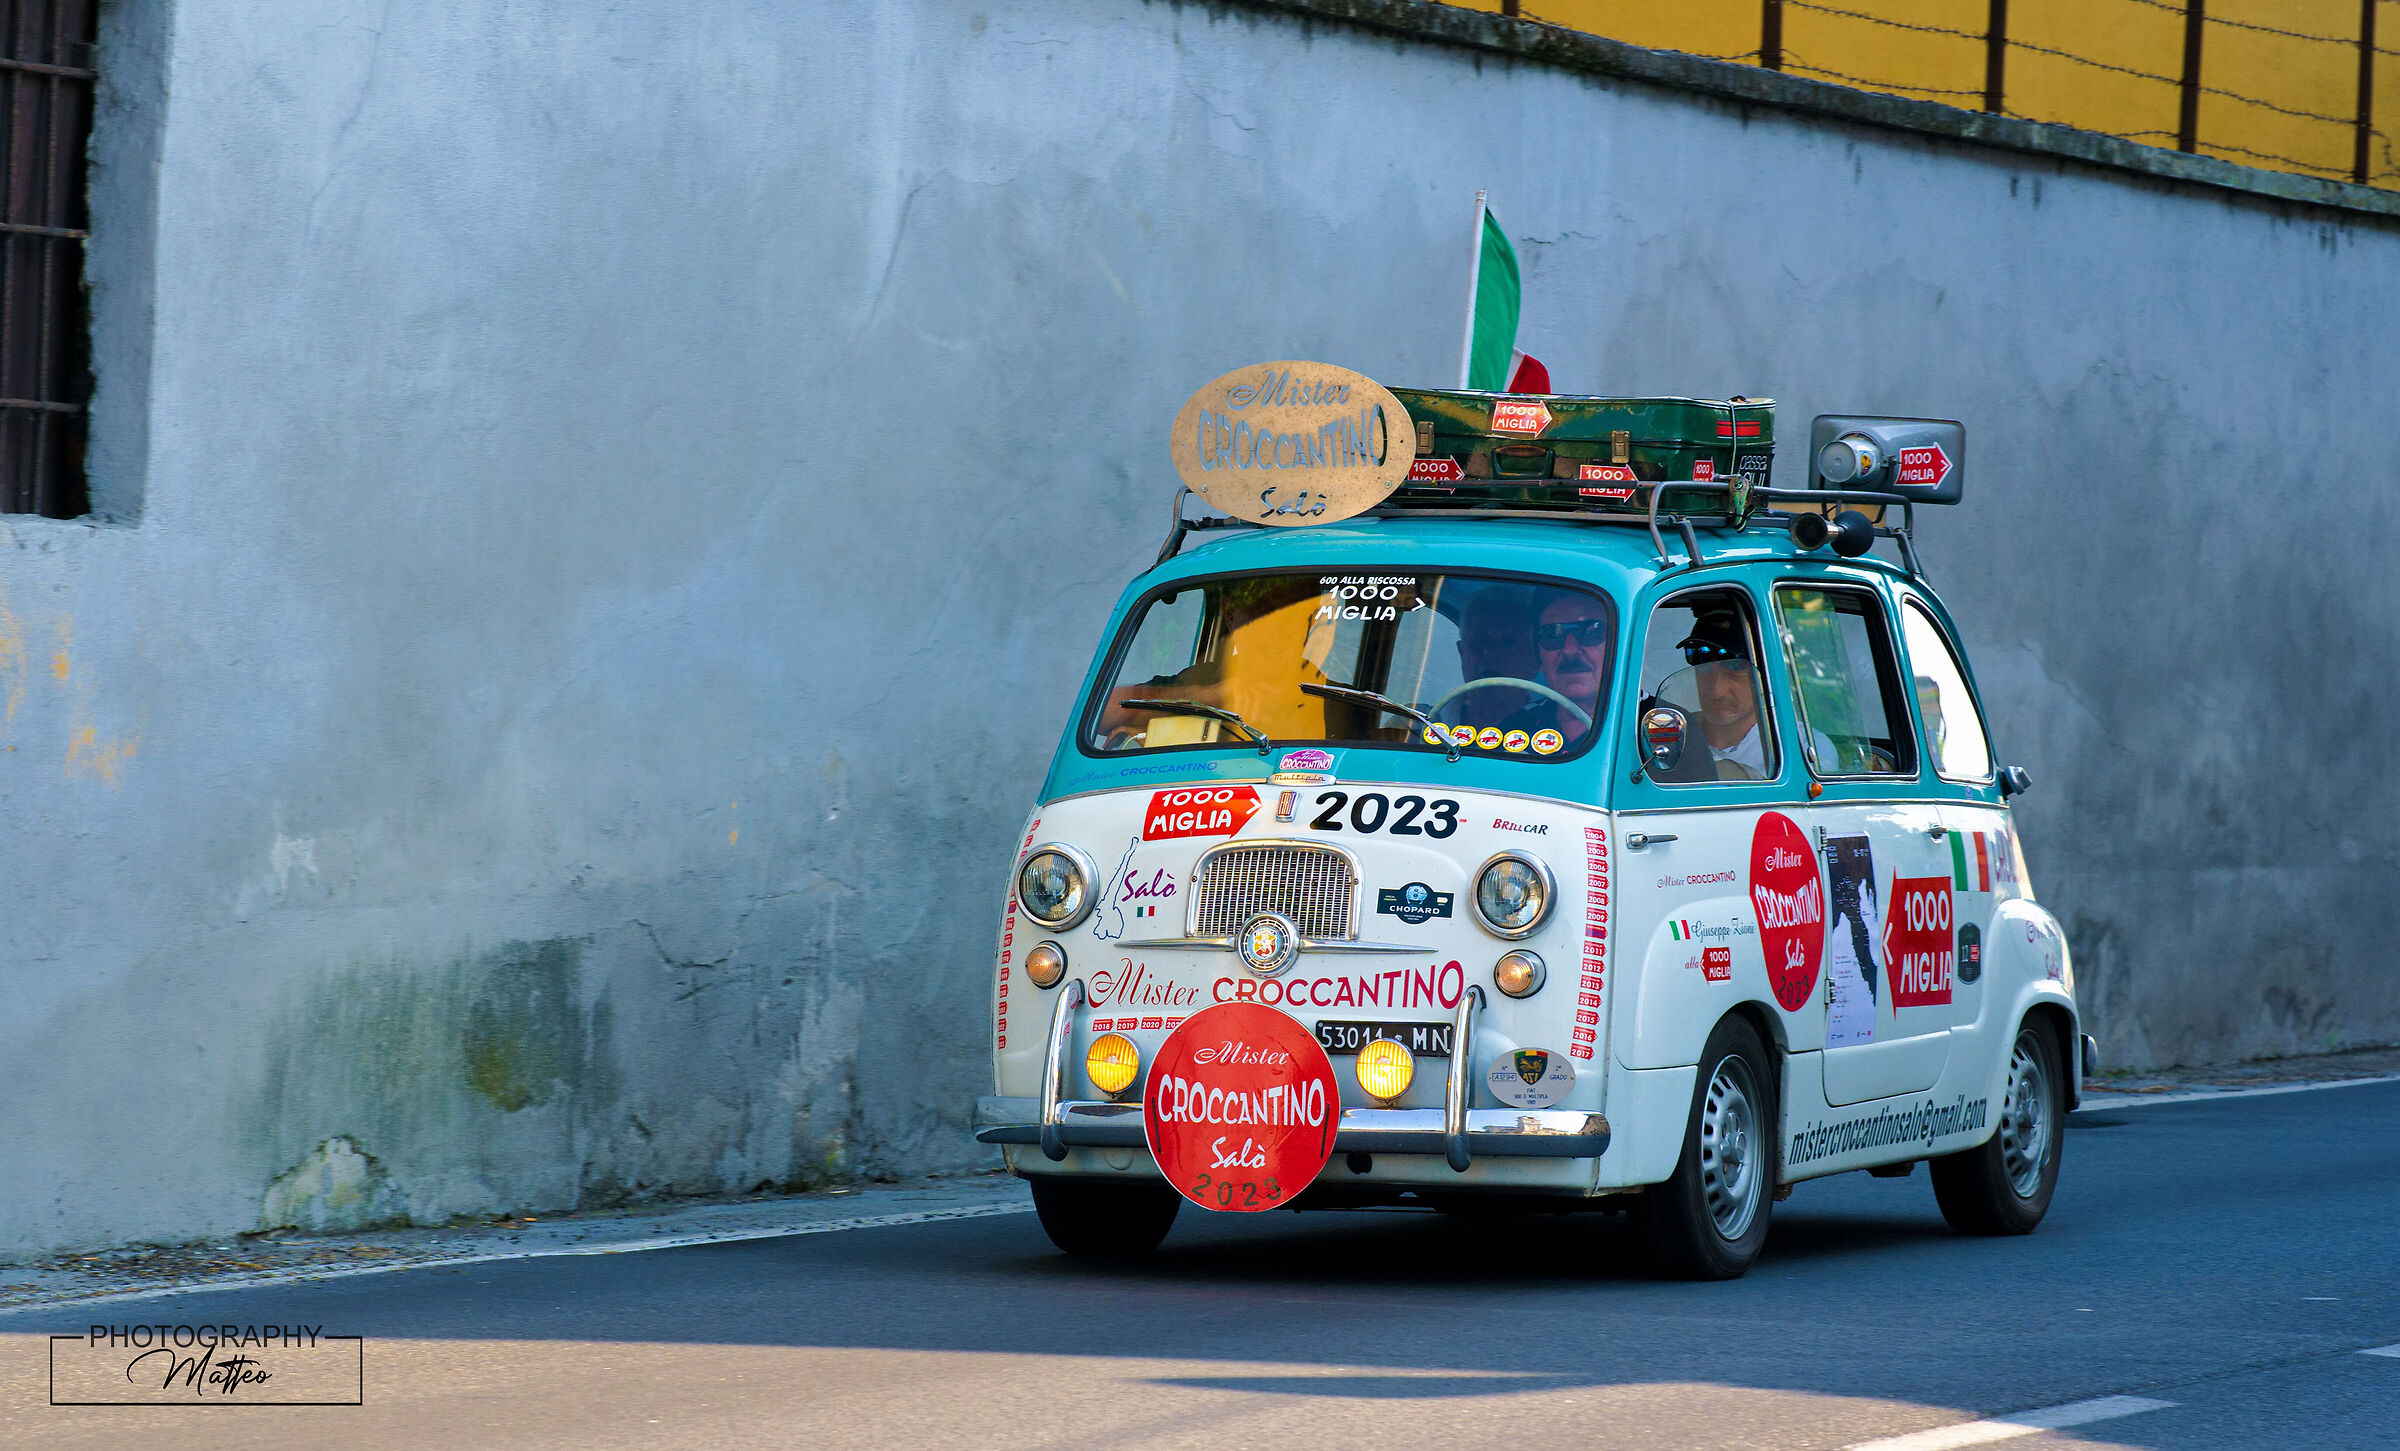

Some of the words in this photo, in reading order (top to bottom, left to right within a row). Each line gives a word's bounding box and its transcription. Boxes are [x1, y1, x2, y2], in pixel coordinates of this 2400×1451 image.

[1227, 370, 1350, 411] Mister
[1502, 406, 1536, 416] 1000
[1496, 418, 1537, 430] MIGLIA
[1198, 403, 1387, 471] CROCCANTINO
[1904, 453, 1932, 465] 1000
[1414, 463, 1448, 473] 1000
[1696, 465, 1710, 474] 1000
[1586, 470, 1623, 480] 1000
[1900, 468, 1935, 481] MIGLIA
[1260, 487, 1327, 518] Salò
[1320, 576, 1338, 584] 600
[1340, 576, 1365, 585] ALLA
[1367, 577, 1416, 585] RISCOSSA
[1329, 585, 1399, 600] 1000
[1315, 605, 1396, 621] MIGLIA
[1120, 762, 1218, 777] CROCCANTINO
[1282, 758, 1331, 769] CROCCANTINO
[1162, 789, 1234, 807] 1000
[1149, 809, 1232, 833] MIGLIA
[1309, 791, 1460, 839] 2023
[1586, 831, 1603, 840] 2004
[1588, 847, 1605, 856] 2005
[1765, 847, 1802, 872] Mister
[1588, 863, 1606, 872] 2006
[1122, 868, 1177, 902] Salò
[1588, 879, 1606, 888] 2007
[1657, 875, 1685, 888] Mister
[1686, 870, 1736, 885] CROCCANTINO
[1588, 896, 1605, 905] 2008
[1755, 876, 1821, 930] CROCCANTINO
[1389, 905, 1440, 914] CHOPARD
[1904, 890, 1950, 932] 1000
[1587, 912, 1605, 921] 2009
[1584, 946, 1602, 955] 2011
[1709, 951, 1729, 962] 1000
[1785, 938, 1805, 971] Salò
[1583, 963, 1601, 972] 2012
[1709, 966, 1731, 978] MIGLIA
[1900, 951, 1952, 994] MIGLIA
[1088, 957, 1199, 1008] Mister
[1213, 960, 1464, 1009] CROCCANTINO
[1581, 980, 1600, 989] 2013
[1778, 974, 1810, 1005] 2023
[1579, 997, 1598, 1007] 2014
[1577, 1014, 1595, 1024] 2015
[1117, 1022, 1134, 1030] 2019
[1412, 1027, 1449, 1053] MN
[1574, 1031, 1592, 1041] 2016
[1193, 1041, 1290, 1065] Mister
[1571, 1048, 1590, 1058] 2017
[1157, 1073, 1326, 1128] CROCCANTINO
[1788, 1094, 1987, 1165] mistercroccantinosalo@gmail.com
[1210, 1136, 1266, 1169] Salò
[1191, 1173, 1283, 1207] 2023
